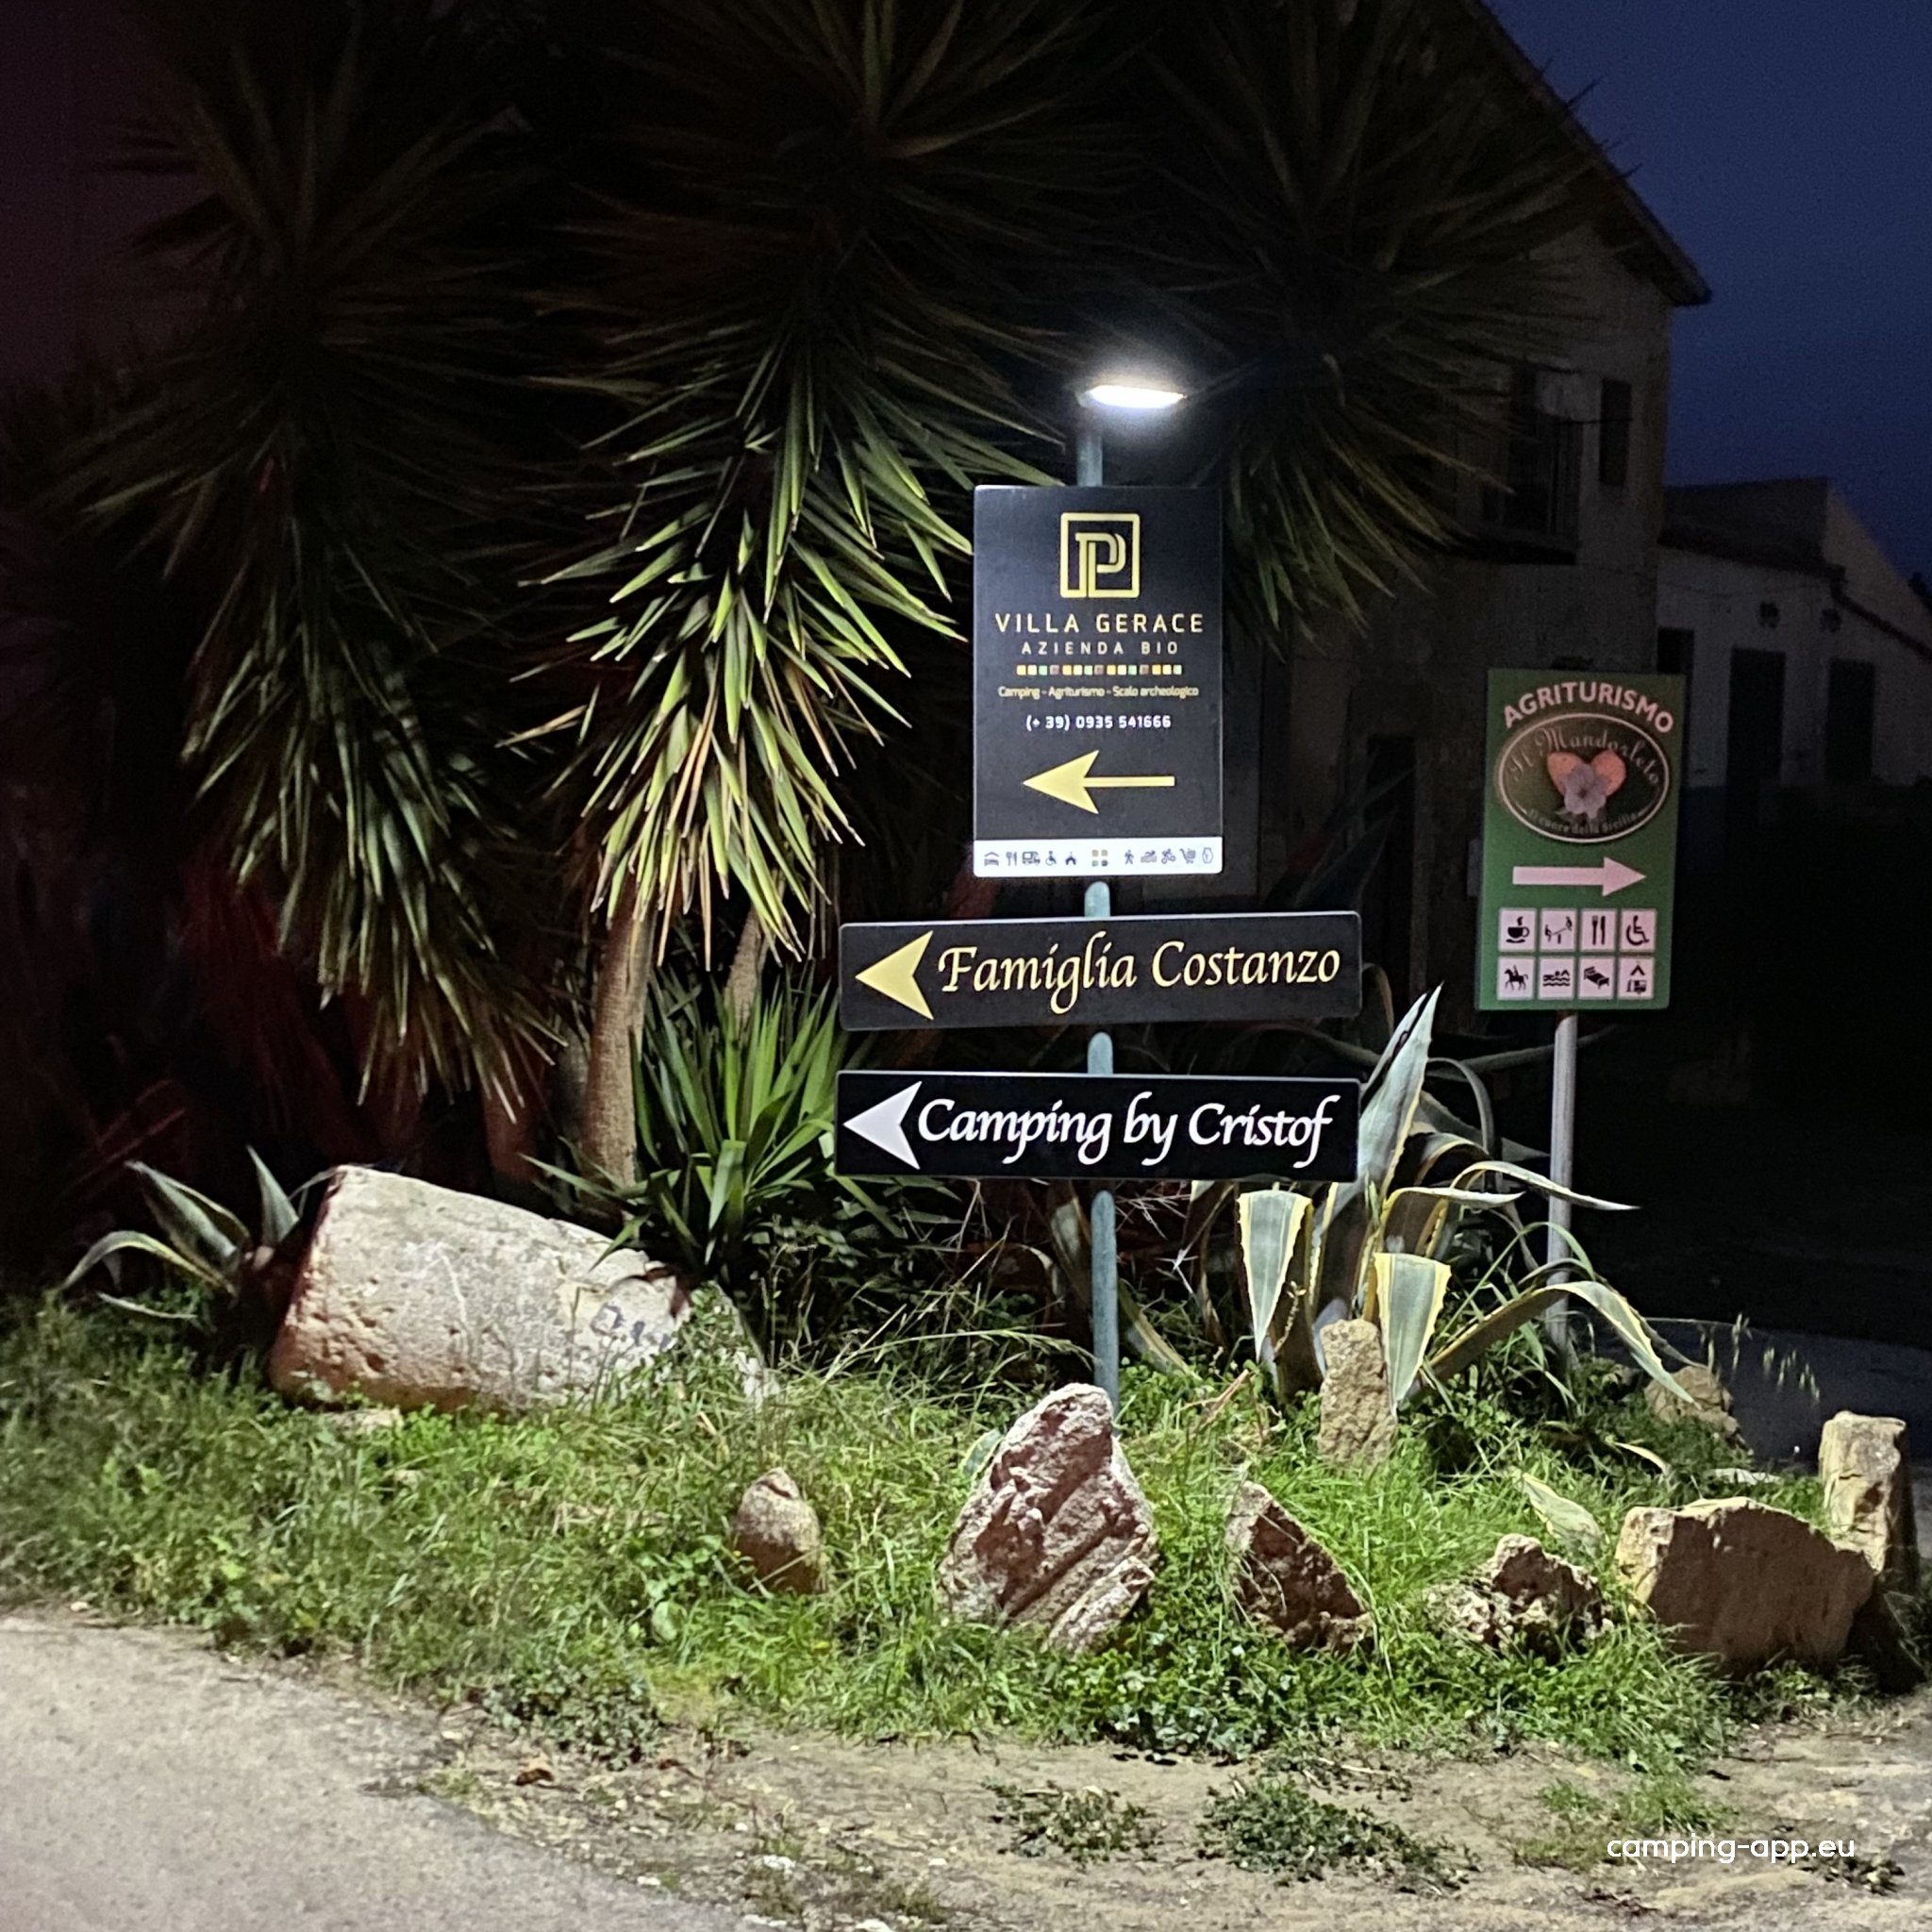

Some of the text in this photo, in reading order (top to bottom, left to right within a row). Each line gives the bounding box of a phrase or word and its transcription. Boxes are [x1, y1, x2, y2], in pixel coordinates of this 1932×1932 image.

[994, 613, 1205, 633] VILLA GERACE
[1021, 641, 1178, 655] AZIENDA BIO
[998, 686, 1041, 700] Camping
[1048, 686, 1106, 700] Agriturismo
[1140, 685, 1199, 699] archeologico
[1504, 681, 1674, 733] AGRITURISMO
[1045, 714, 1070, 731] 39)
[1075, 715, 1113, 729] 0935
[1118, 715, 1172, 729] 541666
[937, 930, 1341, 1015] Famiglia Costanzo
[917, 1091, 1341, 1169] Camping by Cristof
